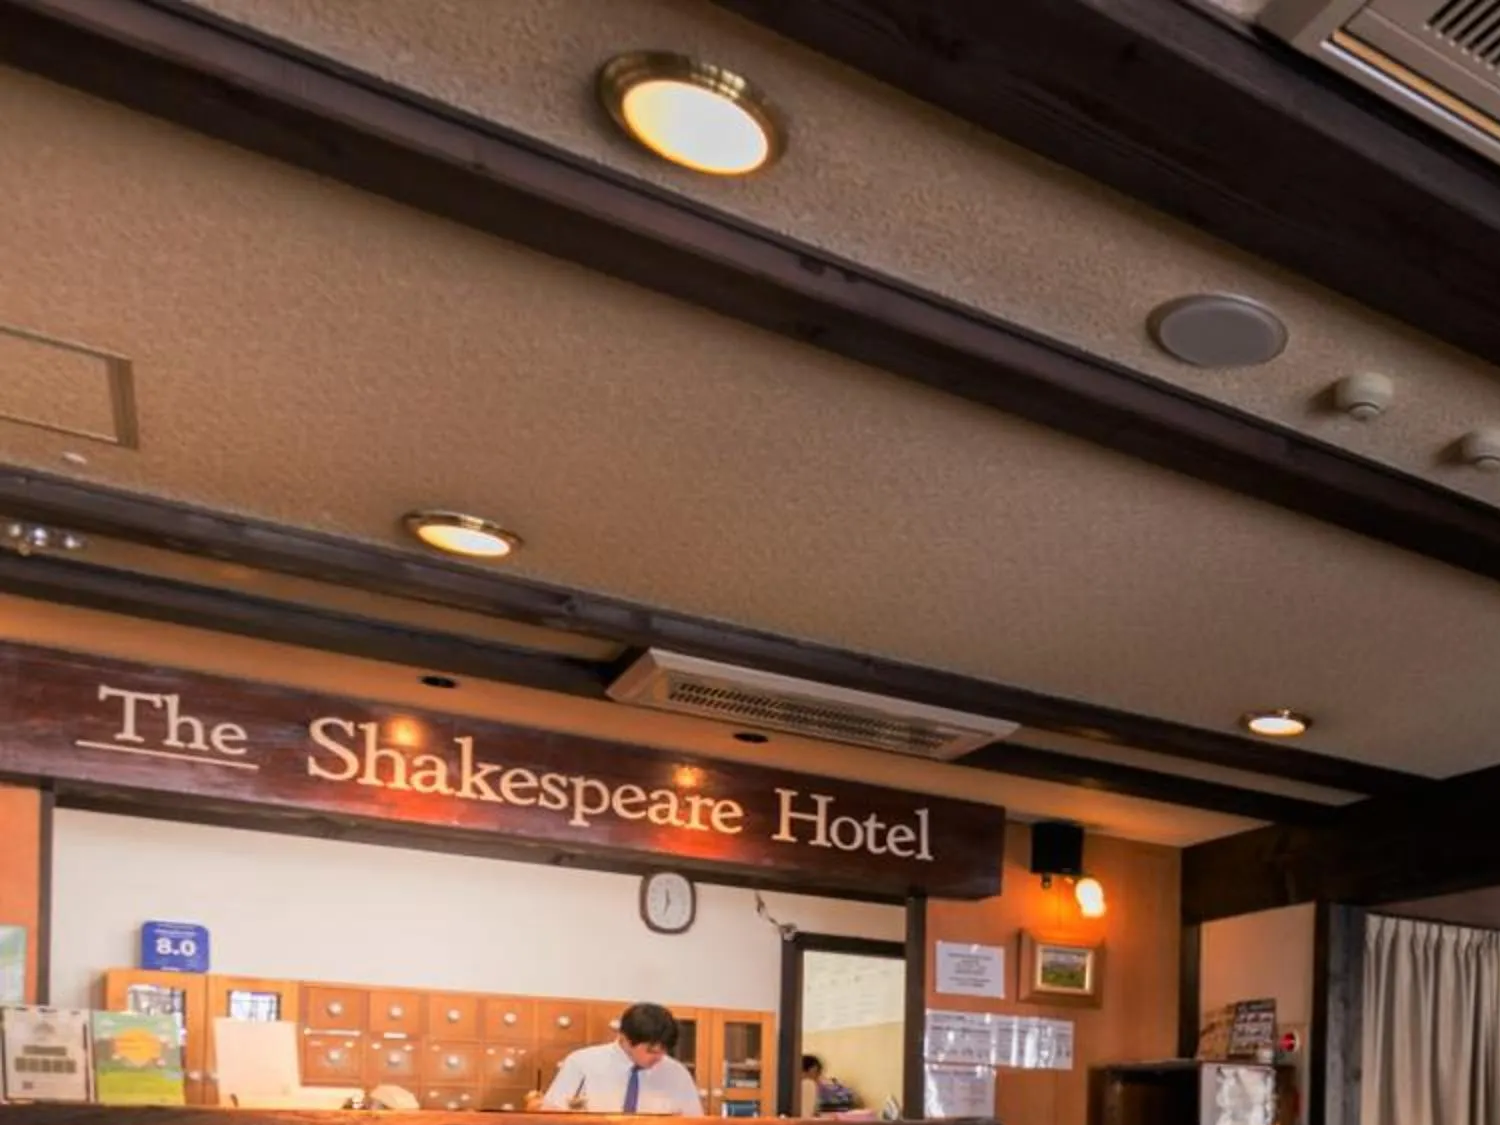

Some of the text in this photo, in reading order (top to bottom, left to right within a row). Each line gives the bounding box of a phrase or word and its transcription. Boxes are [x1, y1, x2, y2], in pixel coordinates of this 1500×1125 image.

[98, 684, 934, 861] The Shakespeare Hotel
[156, 937, 197, 957] 8.0
